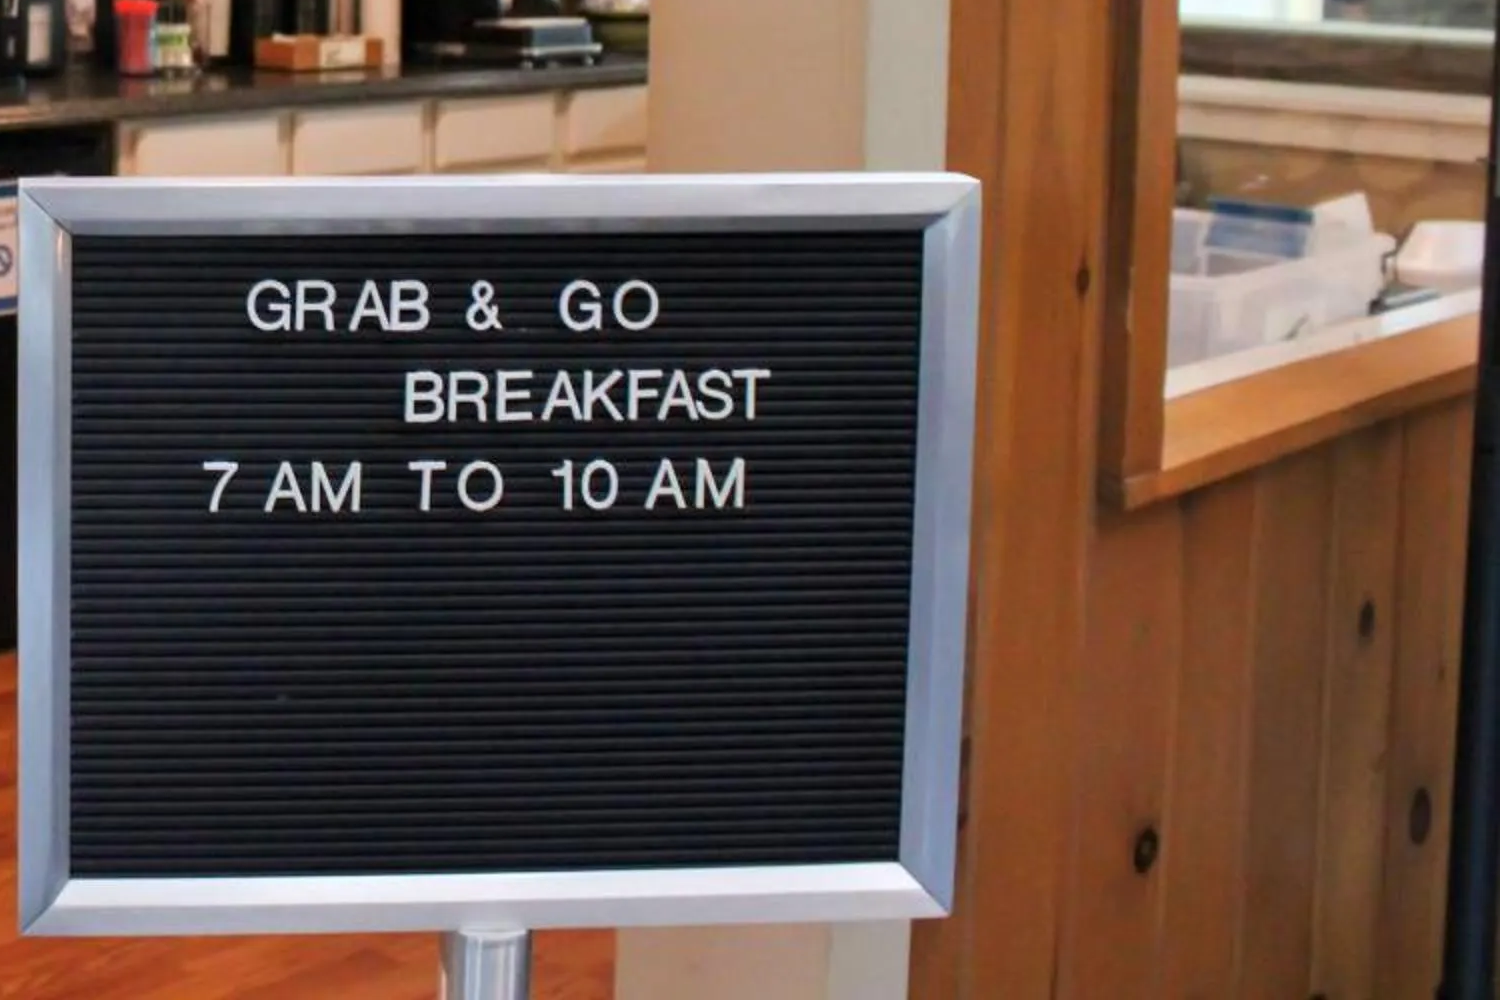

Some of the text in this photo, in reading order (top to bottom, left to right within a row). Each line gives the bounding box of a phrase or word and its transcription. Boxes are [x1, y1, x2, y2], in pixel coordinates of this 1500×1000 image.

[246, 279, 660, 332] GRAB & GO
[403, 368, 771, 423] BREAKFAST
[203, 458, 747, 512] 7 AM TO 10 AM
